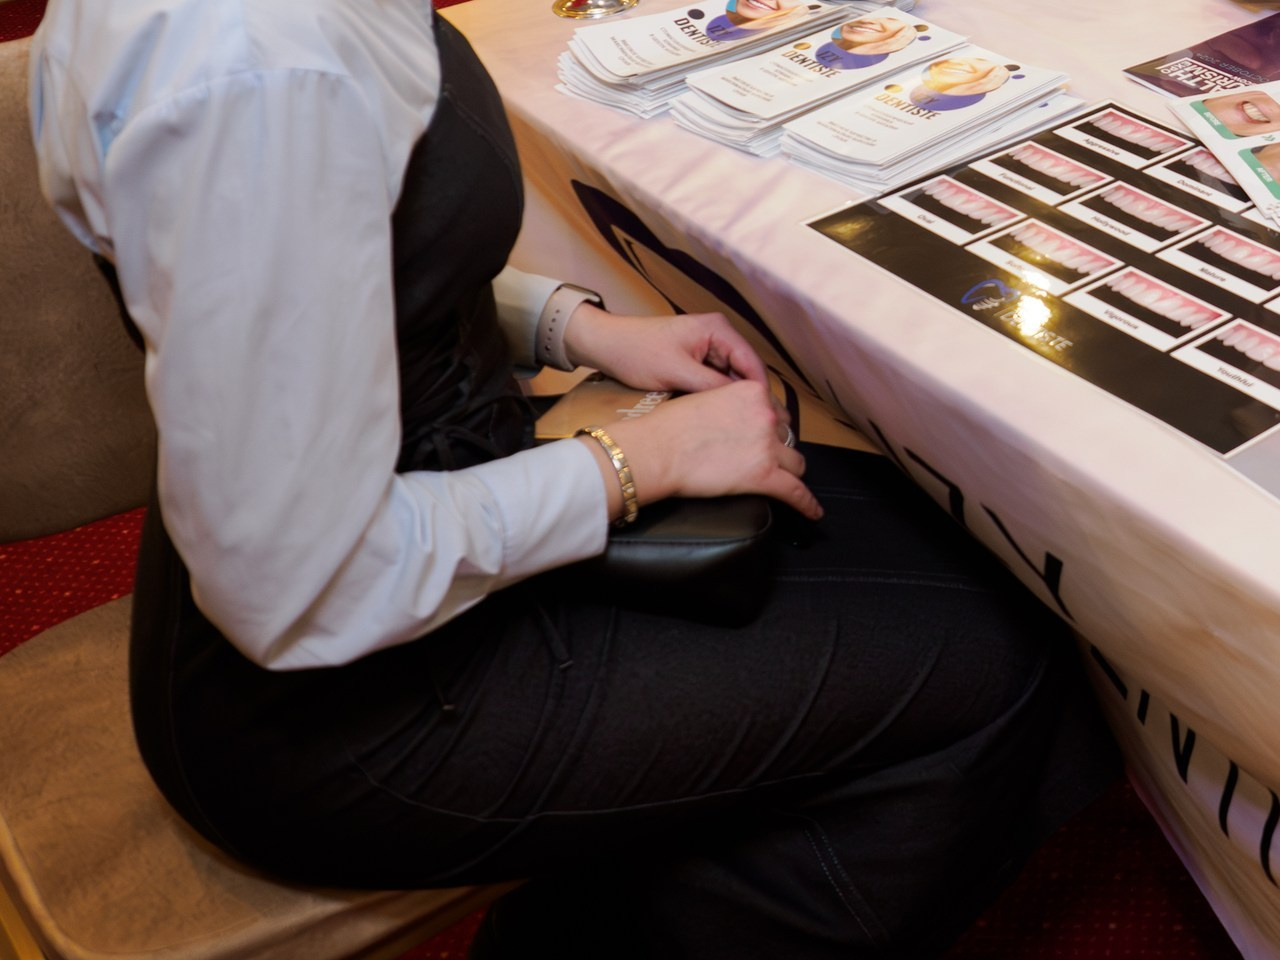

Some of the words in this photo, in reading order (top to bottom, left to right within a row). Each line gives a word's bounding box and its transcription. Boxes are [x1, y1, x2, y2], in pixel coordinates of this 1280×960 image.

[781, 49, 843, 79] DENTISTE
[874, 93, 942, 120] DENTISTE
[1082, 138, 1121, 157] Aggressive
[997, 171, 1036, 192] Functional
[1255, 167, 1273, 183] AFTER
[1177, 178, 1213, 198] Dominant
[916, 213, 935, 226] Oval
[1092, 215, 1131, 238] Hollywood
[1199, 266, 1227, 283] Mature
[1104, 308, 1140, 331] Vigorous
[1216, 365, 1254, 388] Youthful
